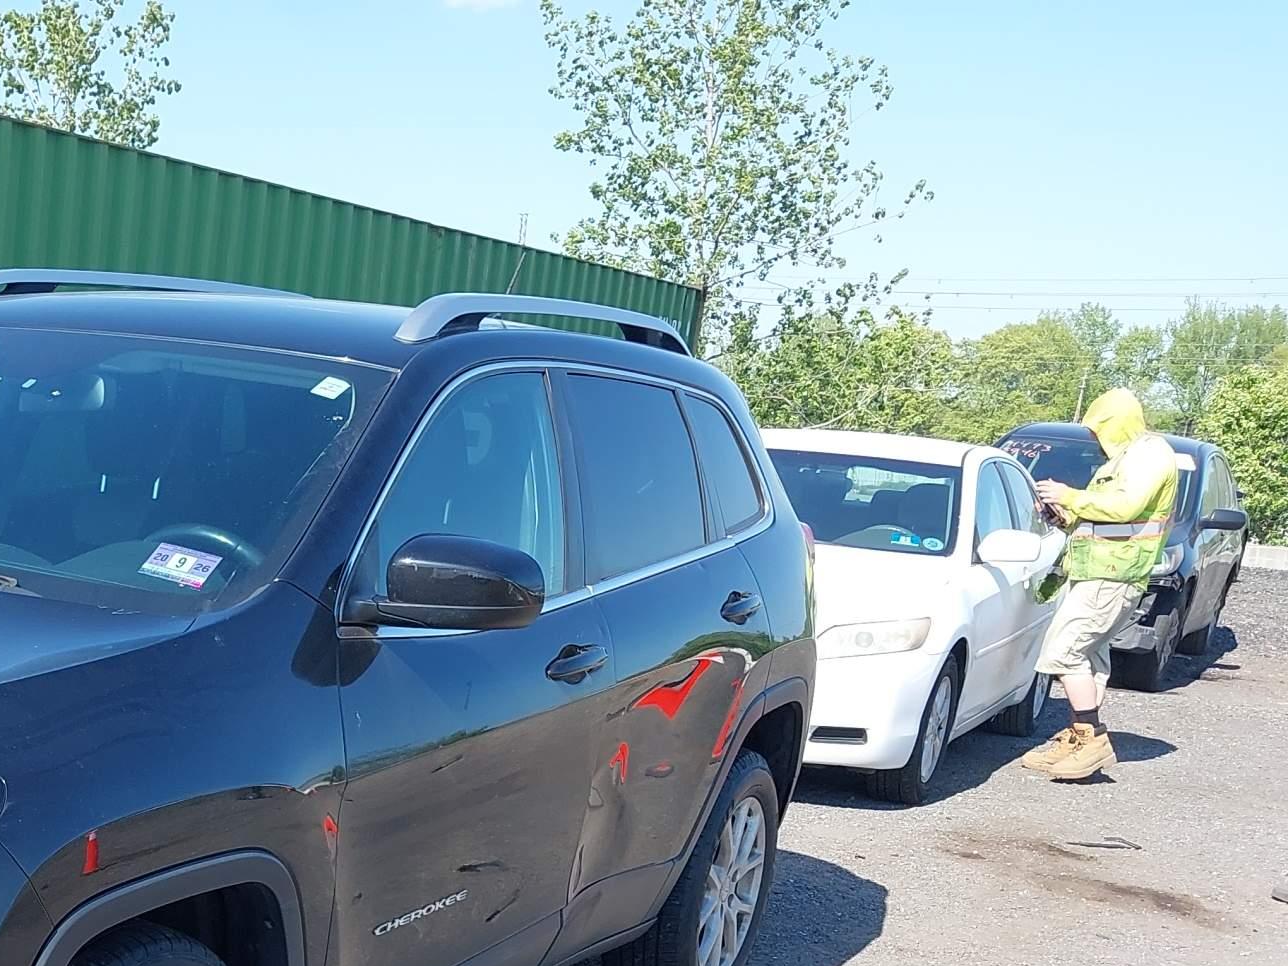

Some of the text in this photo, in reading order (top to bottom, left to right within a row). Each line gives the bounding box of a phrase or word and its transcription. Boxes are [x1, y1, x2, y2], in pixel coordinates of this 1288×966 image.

[153, 552, 169, 562] 20
[176, 557, 187, 568] 9
[194, 563, 211, 573] 26
[374, 889, 469, 936] CHEROKEE
